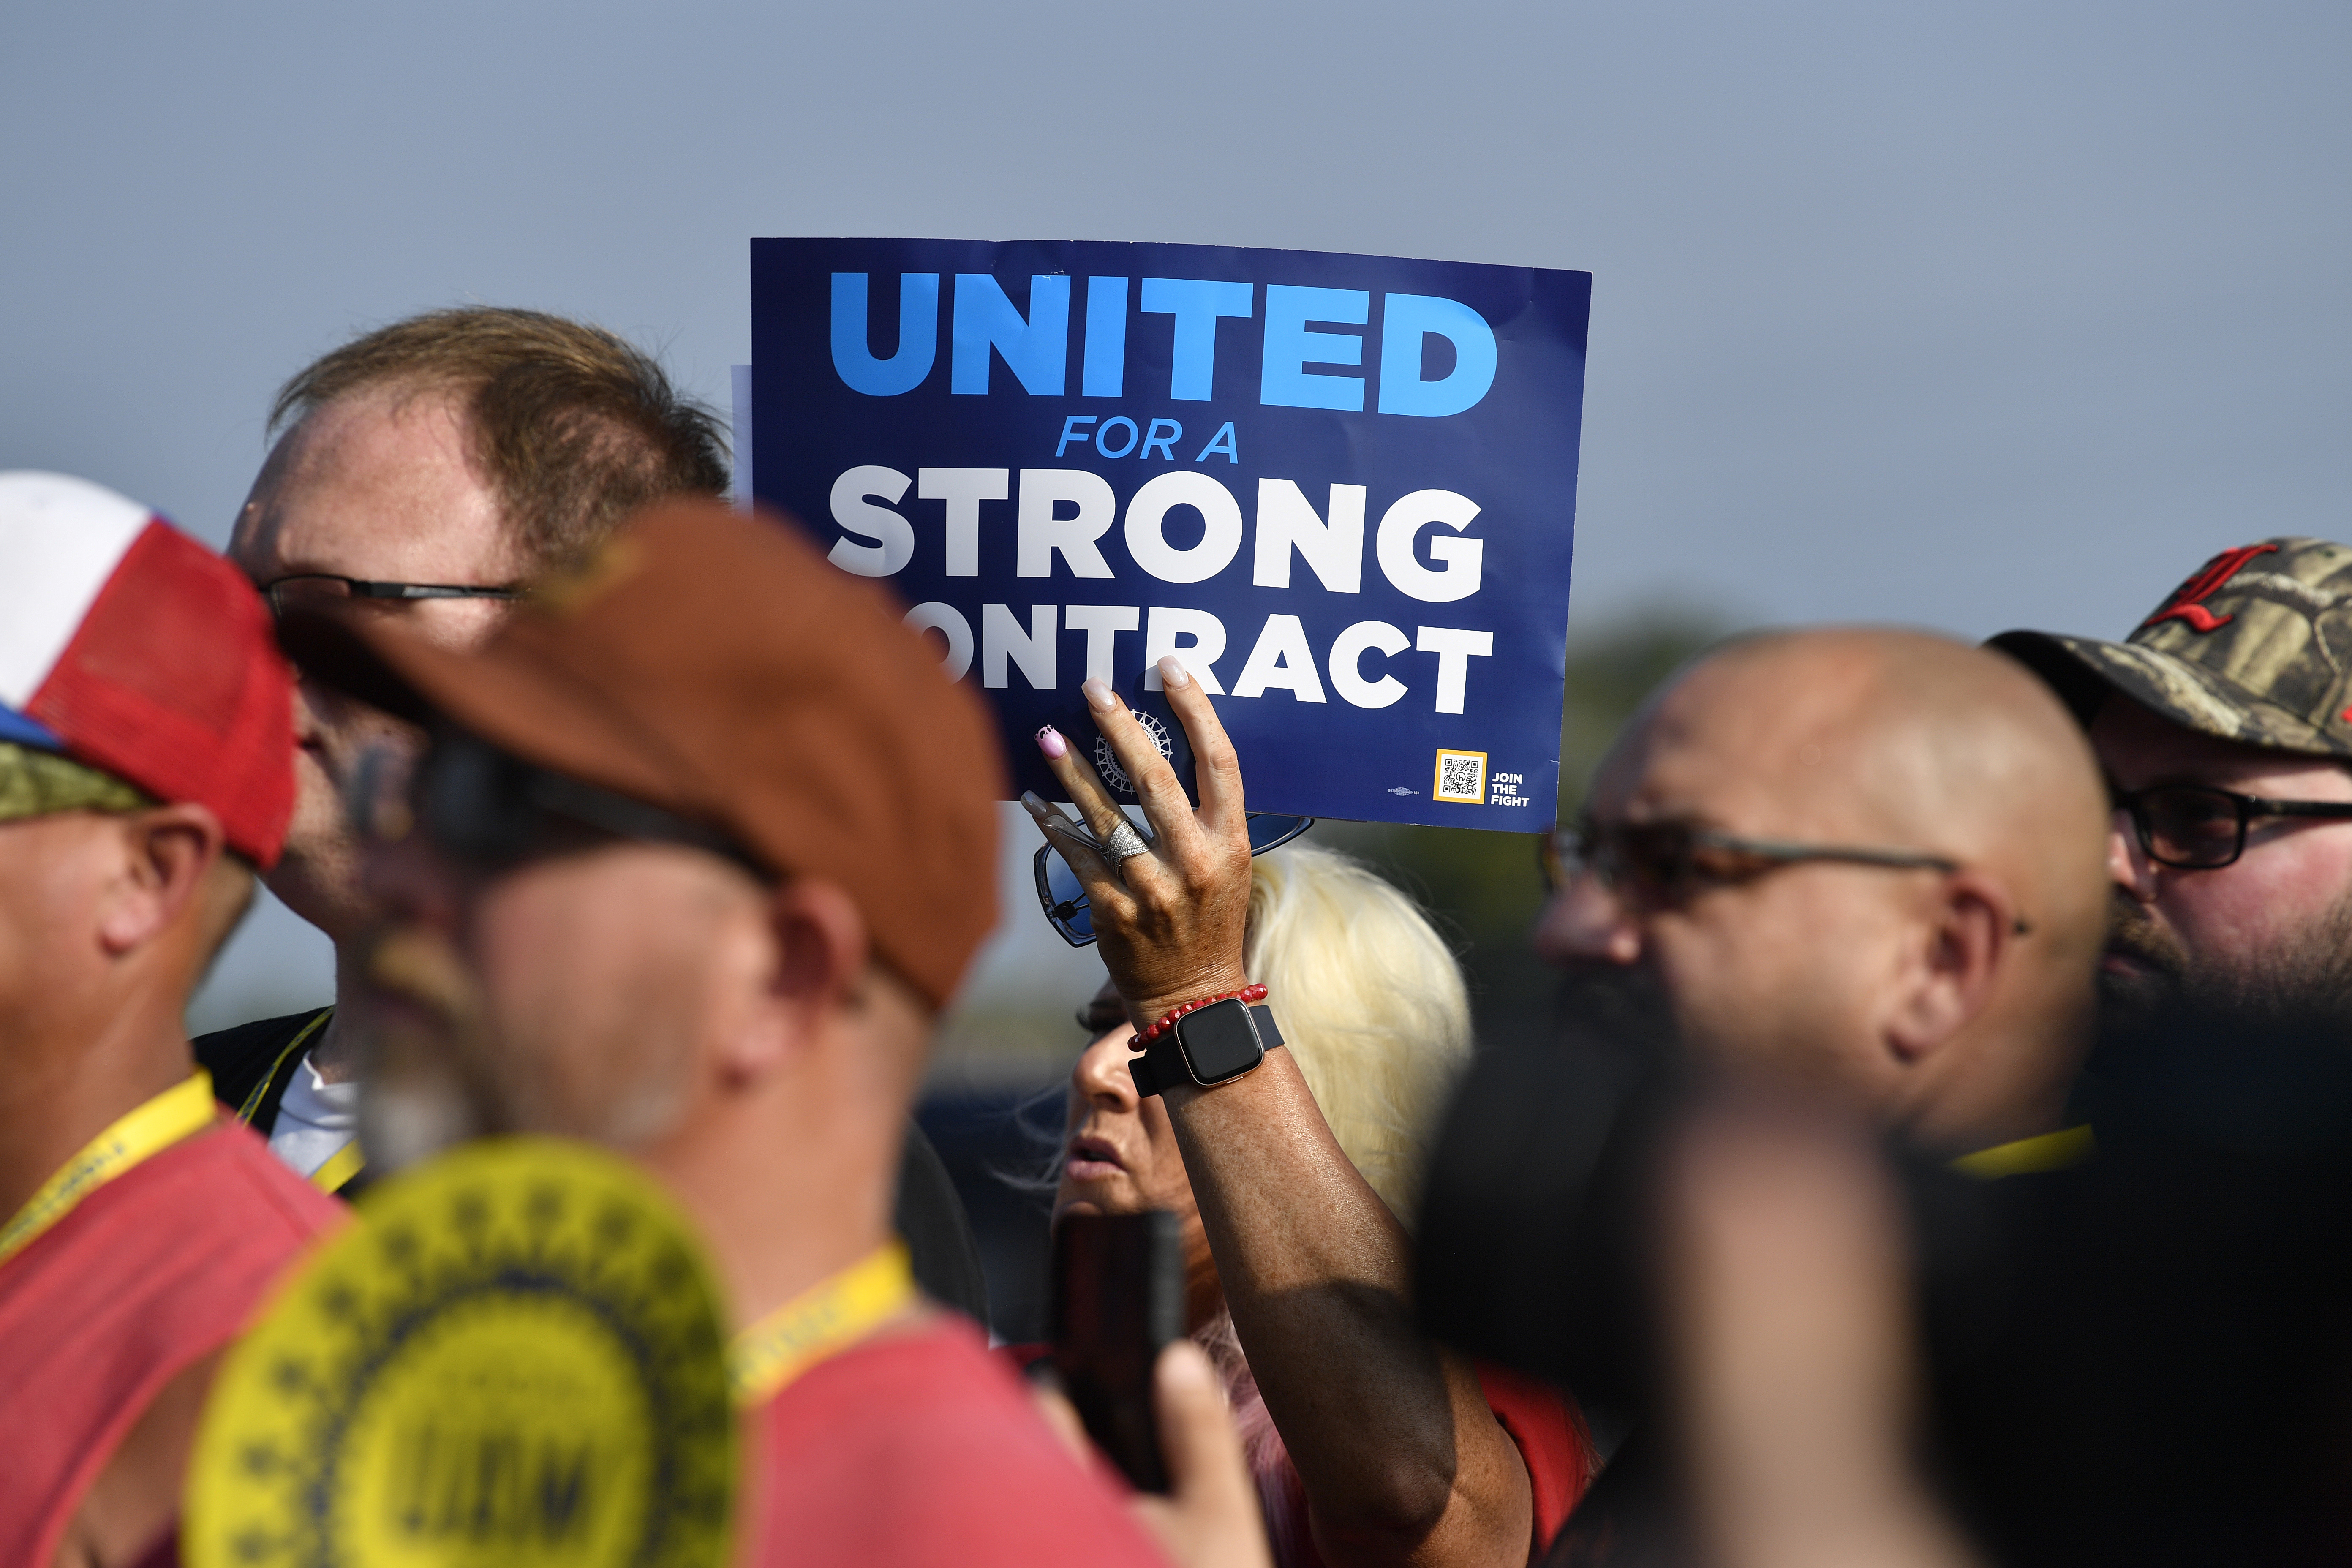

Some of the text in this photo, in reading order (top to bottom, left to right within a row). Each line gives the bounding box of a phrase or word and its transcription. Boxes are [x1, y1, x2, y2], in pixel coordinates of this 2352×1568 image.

[831, 272, 1497, 417] UNITED
[1055, 416, 1238, 464] FOR A
[827, 465, 1484, 603] STRONG
[900, 602, 1493, 714] ONTRACT
[1491, 795, 1530, 807] FIGHT
[1492, 772, 1523, 784] JOIN
[1492, 784, 1517, 795] THE
